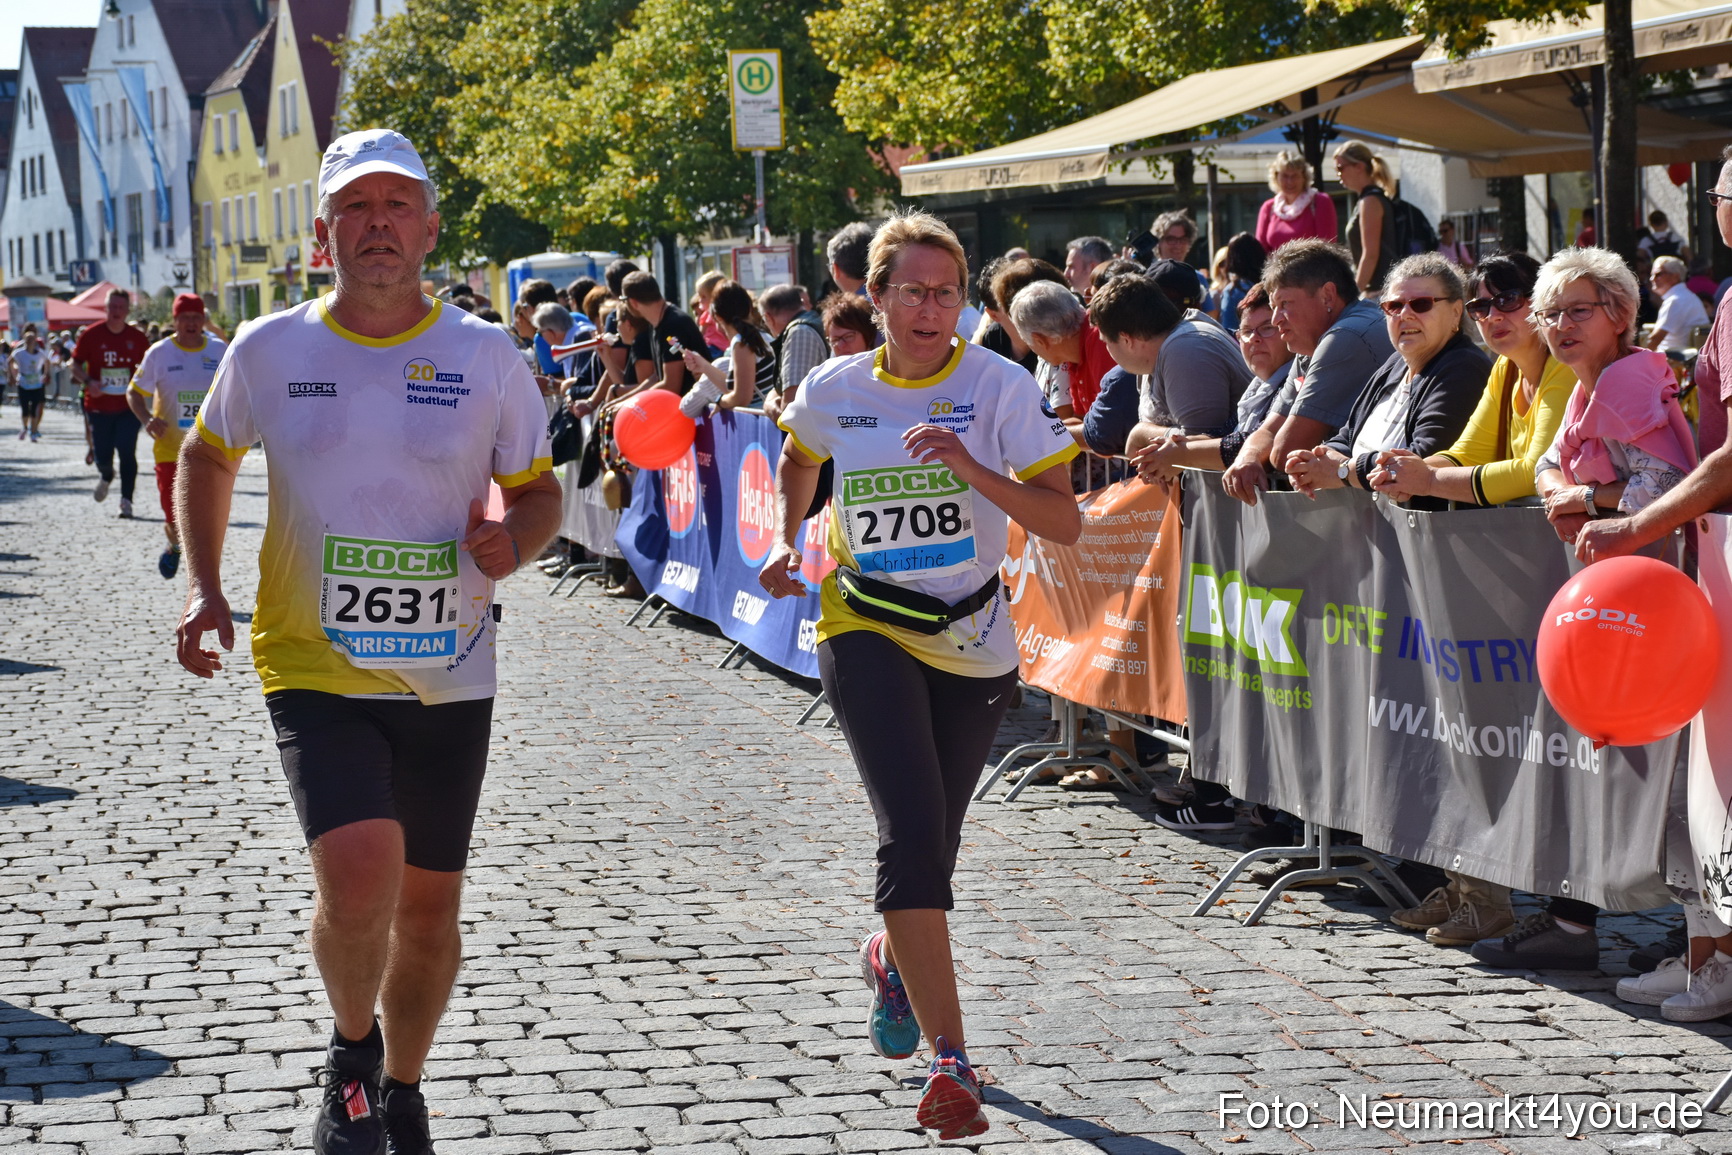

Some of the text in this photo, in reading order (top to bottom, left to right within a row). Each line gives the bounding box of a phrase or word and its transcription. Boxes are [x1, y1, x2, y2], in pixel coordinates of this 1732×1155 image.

[747, 66, 765, 87] H
[407, 364, 435, 381] 20
[437, 373, 463, 383] JAHRE
[288, 382, 337, 393] BOCK
[406, 382, 471, 396] Neumarkter
[406, 394, 459, 409] Stadtlauf
[930, 402, 953, 416] 20
[838, 416, 878, 425] BOCK
[851, 469, 955, 498] BOCK
[741, 470, 774, 540] Hervis
[857, 502, 962, 545] 2708
[1130, 509, 1164, 523] Partner
[333, 545, 453, 574] BOCK
[872, 549, 945, 571] Christine
[335, 583, 446, 625] 2631
[1597, 622, 1643, 637] energie
[338, 632, 446, 653] CHRISTIAN
[1127, 660, 1147, 675] 897
